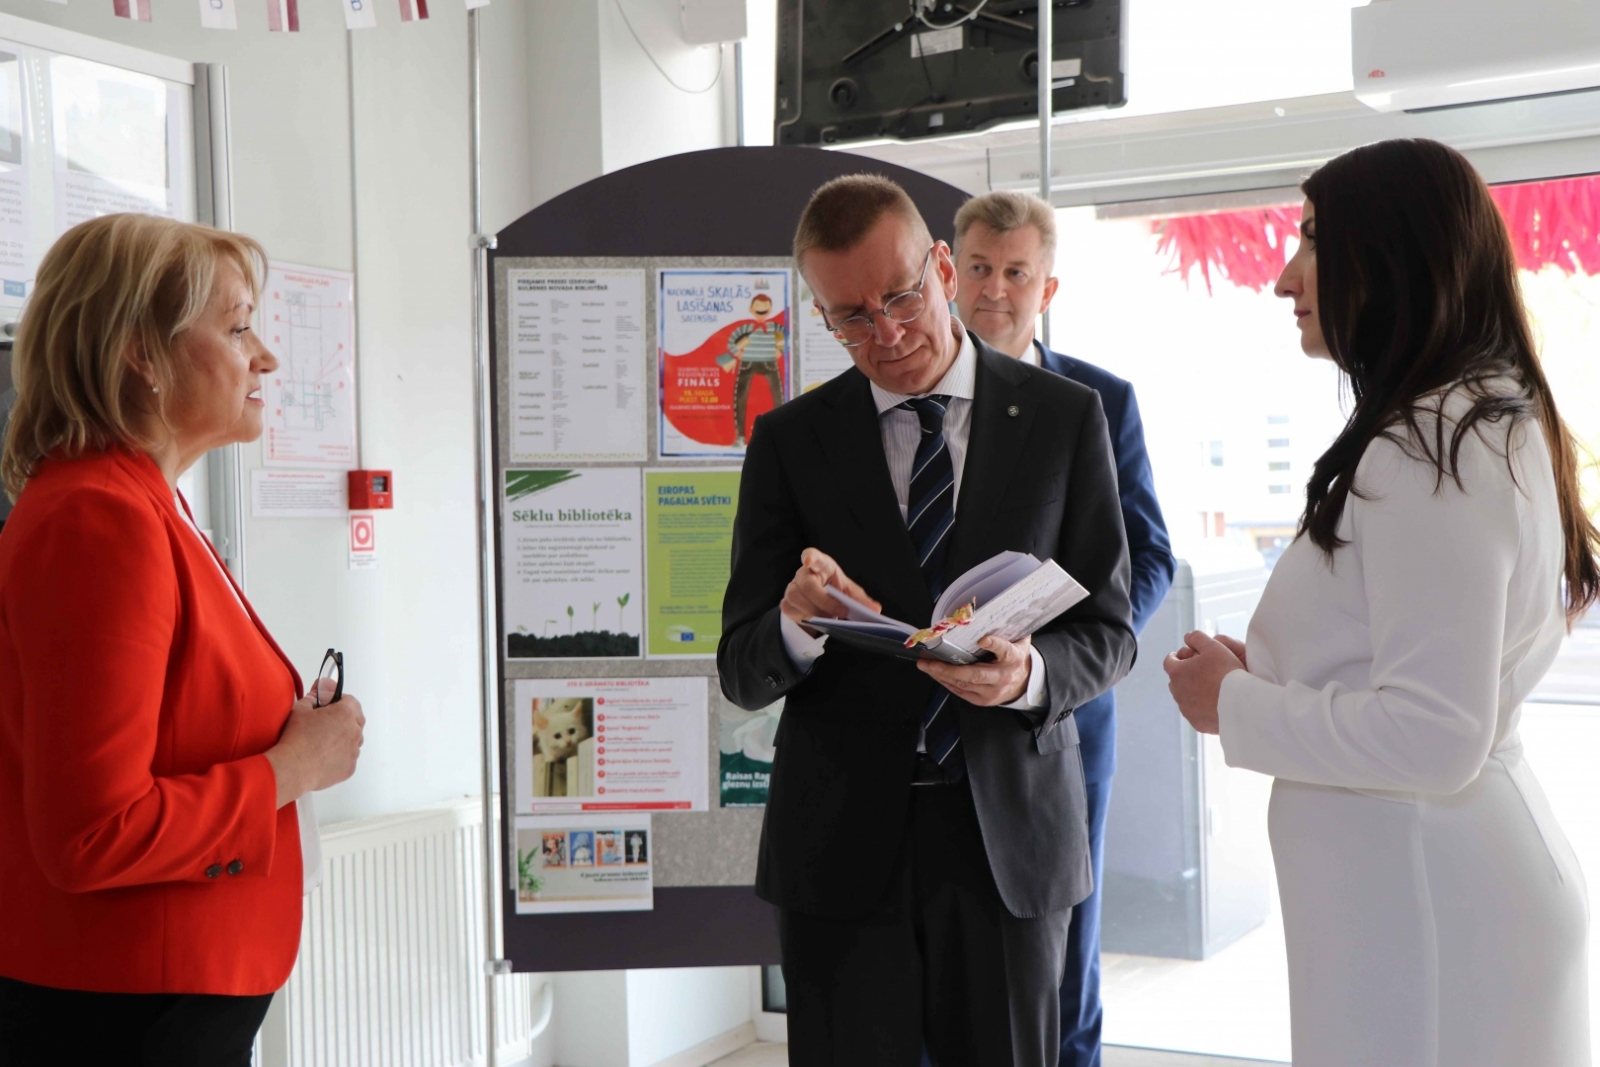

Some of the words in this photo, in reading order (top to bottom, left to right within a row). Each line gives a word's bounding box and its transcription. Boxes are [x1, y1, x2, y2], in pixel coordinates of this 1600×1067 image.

[677, 297, 734, 312] LASĪŠANAS
[677, 377, 720, 387] FINĀLS
[658, 486, 695, 494] EIROPAS
[658, 497, 699, 505] PAGALMA
[702, 495, 731, 505] SVĒTKI
[512, 510, 553, 522] Sēklu
[558, 509, 632, 521] bibliotēka
[725, 772, 752, 780] Raisas
[754, 771, 771, 781] Rag
[722, 780, 751, 791] gleznu
